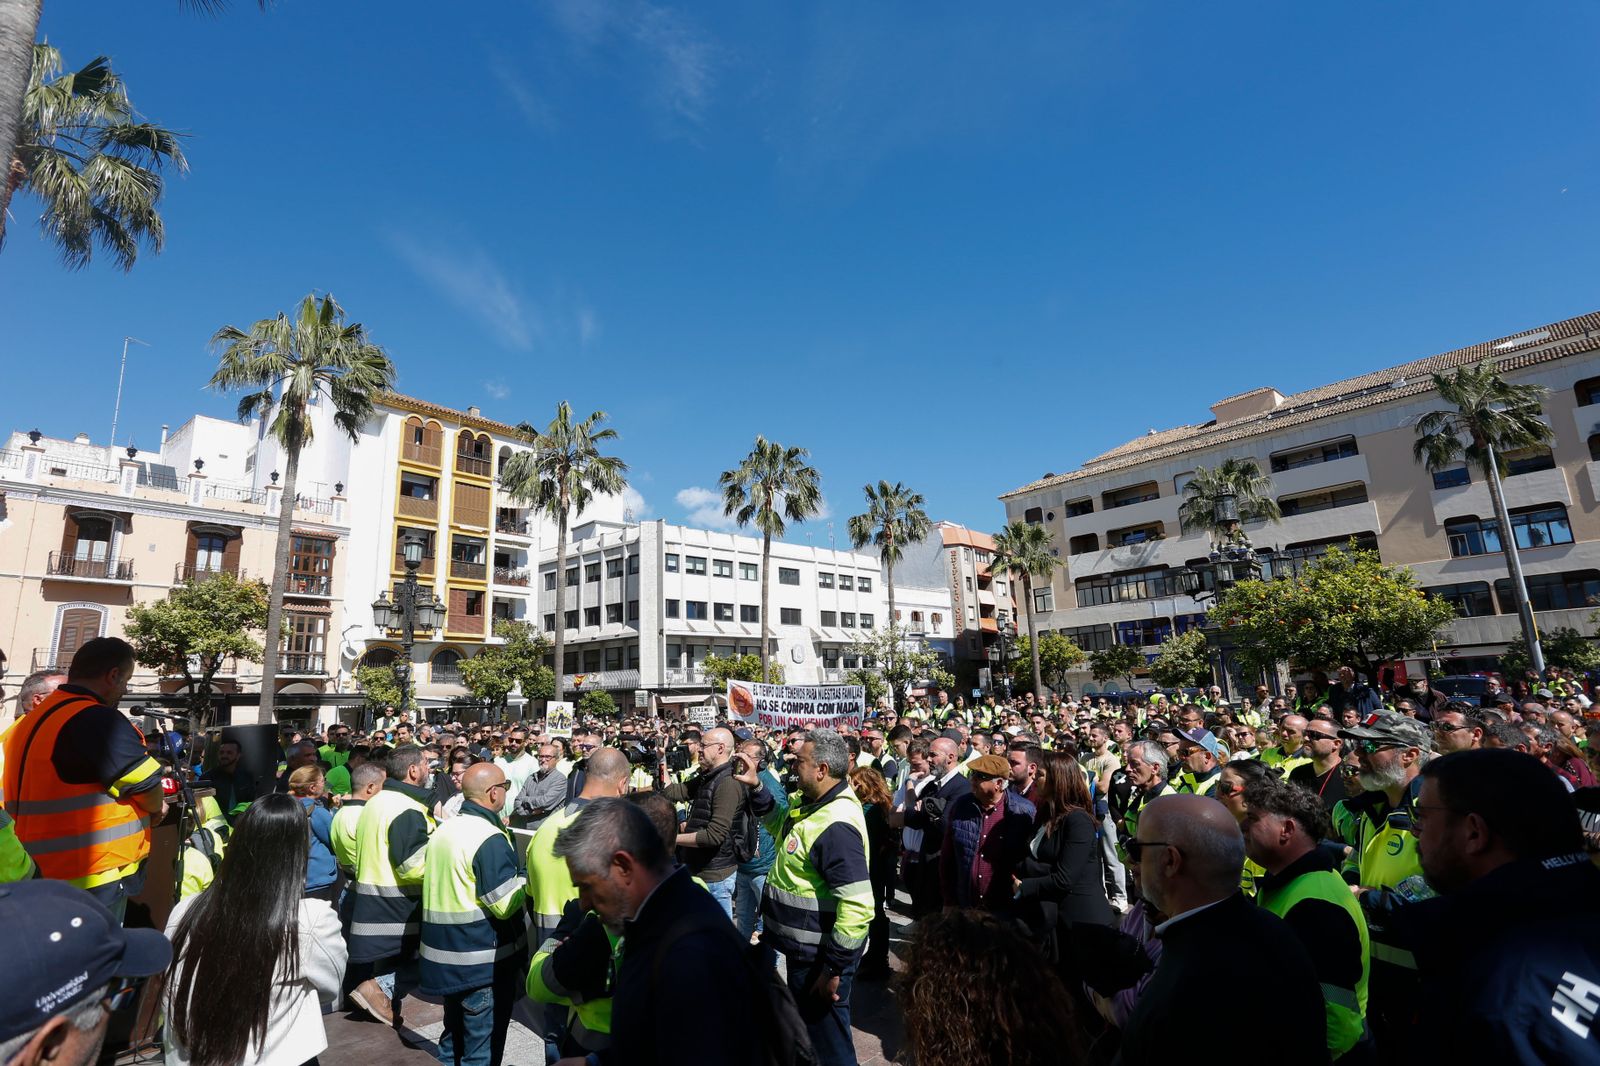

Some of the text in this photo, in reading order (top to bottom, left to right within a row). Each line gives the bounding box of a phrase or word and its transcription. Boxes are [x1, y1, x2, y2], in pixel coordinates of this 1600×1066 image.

[753, 684, 862, 700] EL TIEMPO QUE TENEMOS PARA NUESTRAS FAMILIAS
[756, 698, 859, 715] NO SE COMPRA CON NADA
[758, 713, 773, 726] POR
[775, 715, 786, 728] UN
[1541, 853, 1576, 869] HELLY
[1551, 971, 1600, 1039] HH
